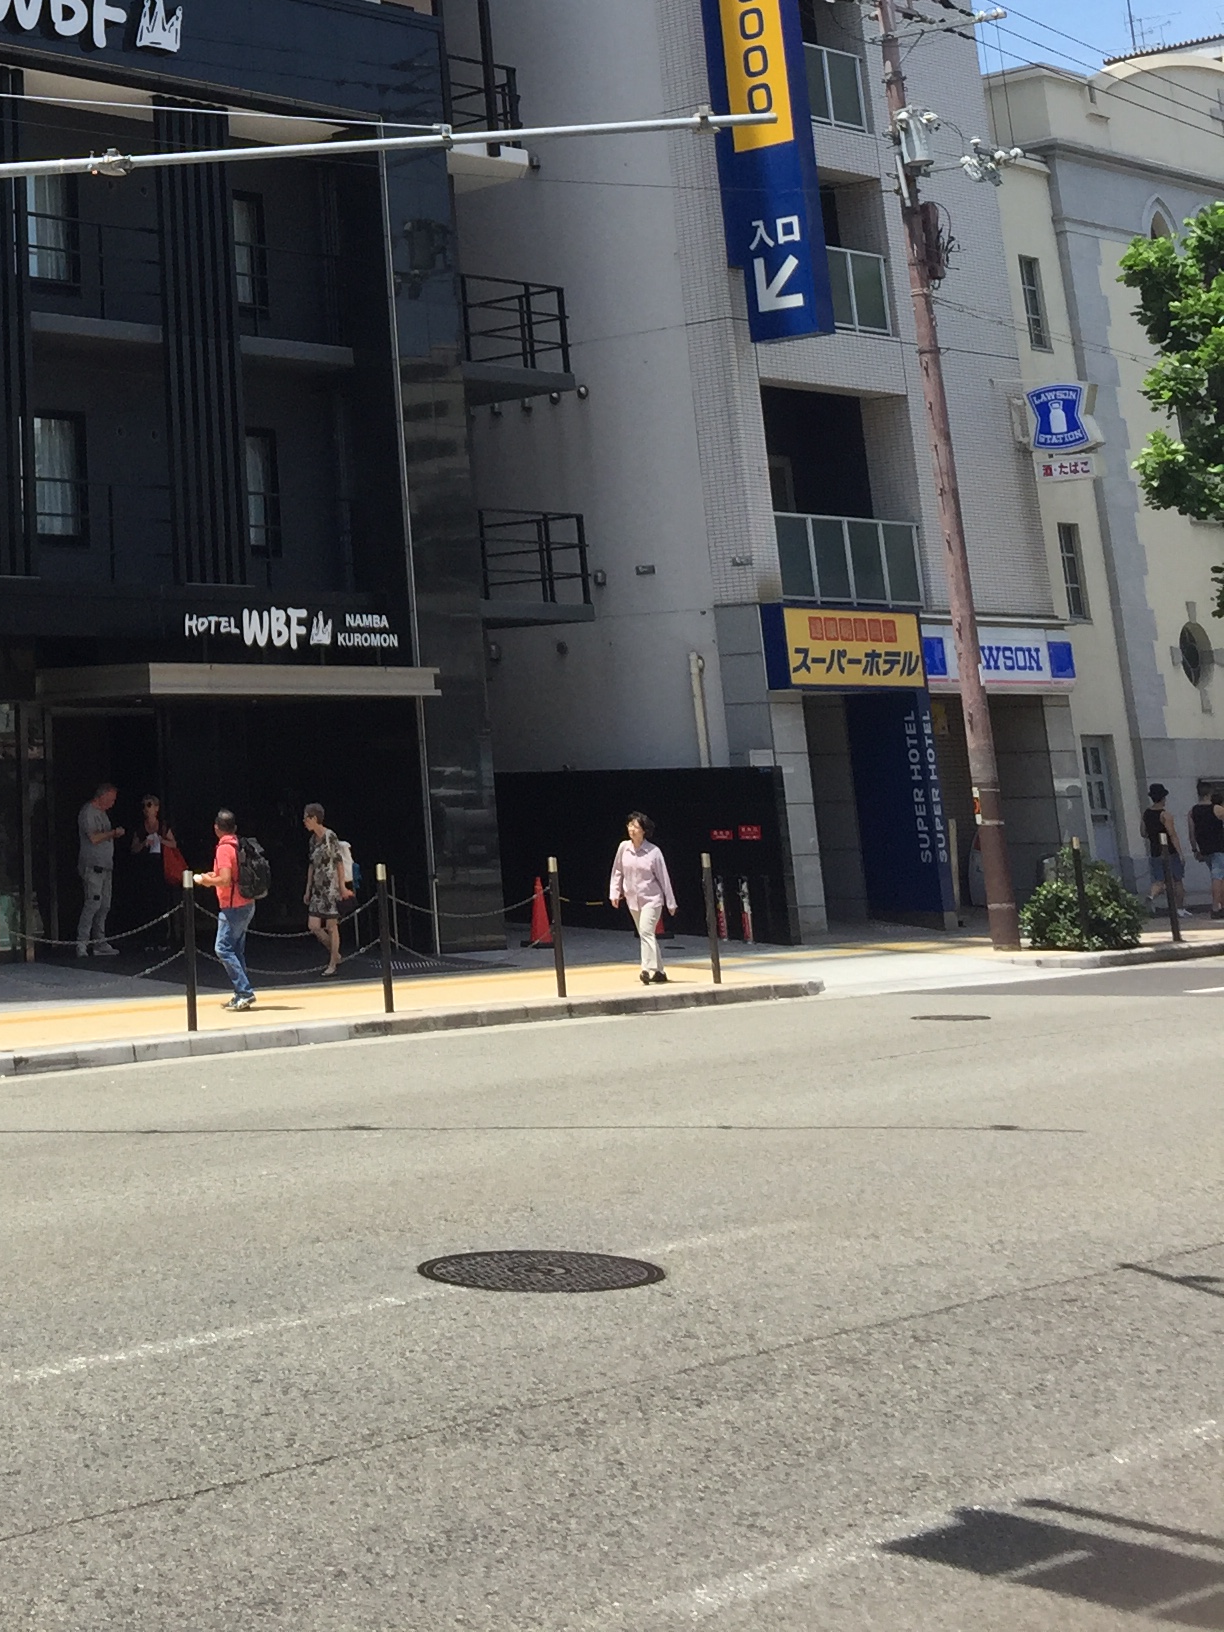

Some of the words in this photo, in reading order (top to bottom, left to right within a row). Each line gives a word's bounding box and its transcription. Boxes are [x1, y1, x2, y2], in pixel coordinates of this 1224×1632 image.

[749, 214, 801, 251] 入口
[1033, 390, 1077, 405] LAWSON
[1038, 429, 1084, 444] STATION
[184, 613, 240, 637] HOTEL
[242, 606, 308, 650] WBF
[345, 613, 389, 629] NAMBA
[337, 632, 398, 648] KUROMON
[792, 647, 920, 677] スーパーホテル
[979, 645, 1044, 672] WSON
[904, 710, 923, 780] HOTEL
[922, 710, 938, 780] HOTEL
[913, 787, 932, 864] SUPER
[931, 787, 948, 864] SUPER
